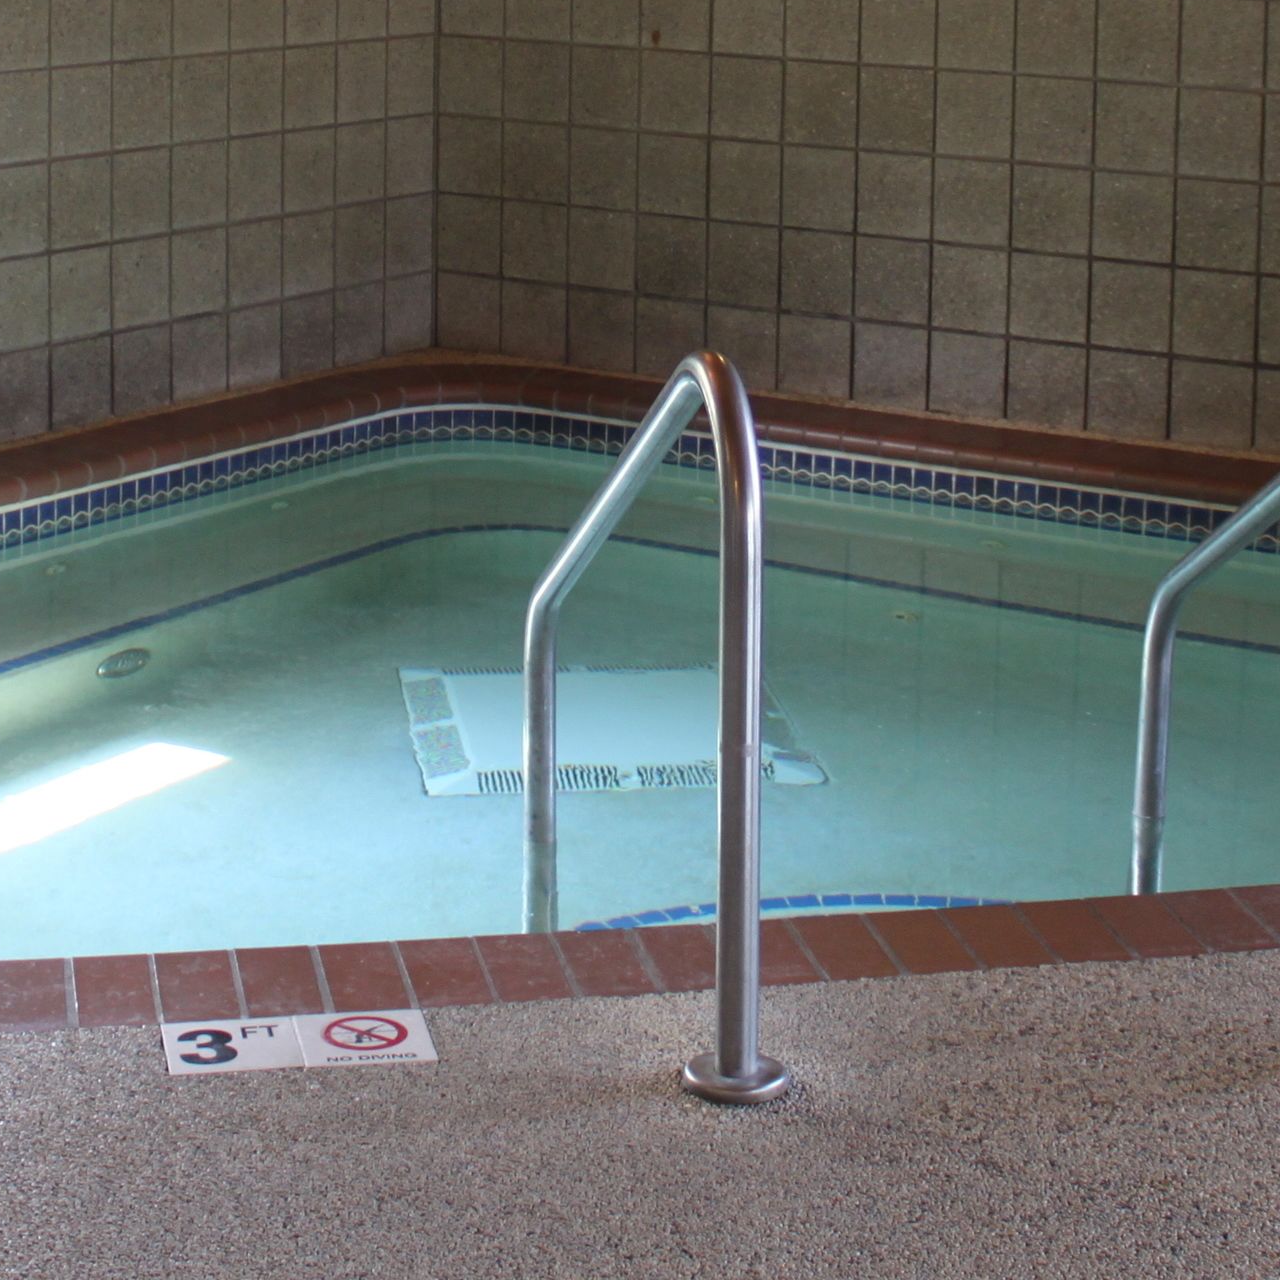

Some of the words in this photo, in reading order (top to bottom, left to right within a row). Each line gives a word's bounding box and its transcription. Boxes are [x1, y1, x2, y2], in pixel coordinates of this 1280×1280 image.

[177, 1029, 238, 1065] 3
[240, 1024, 278, 1040] FT
[326, 1055, 352, 1063] NO
[358, 1052, 418, 1061] DIVING
